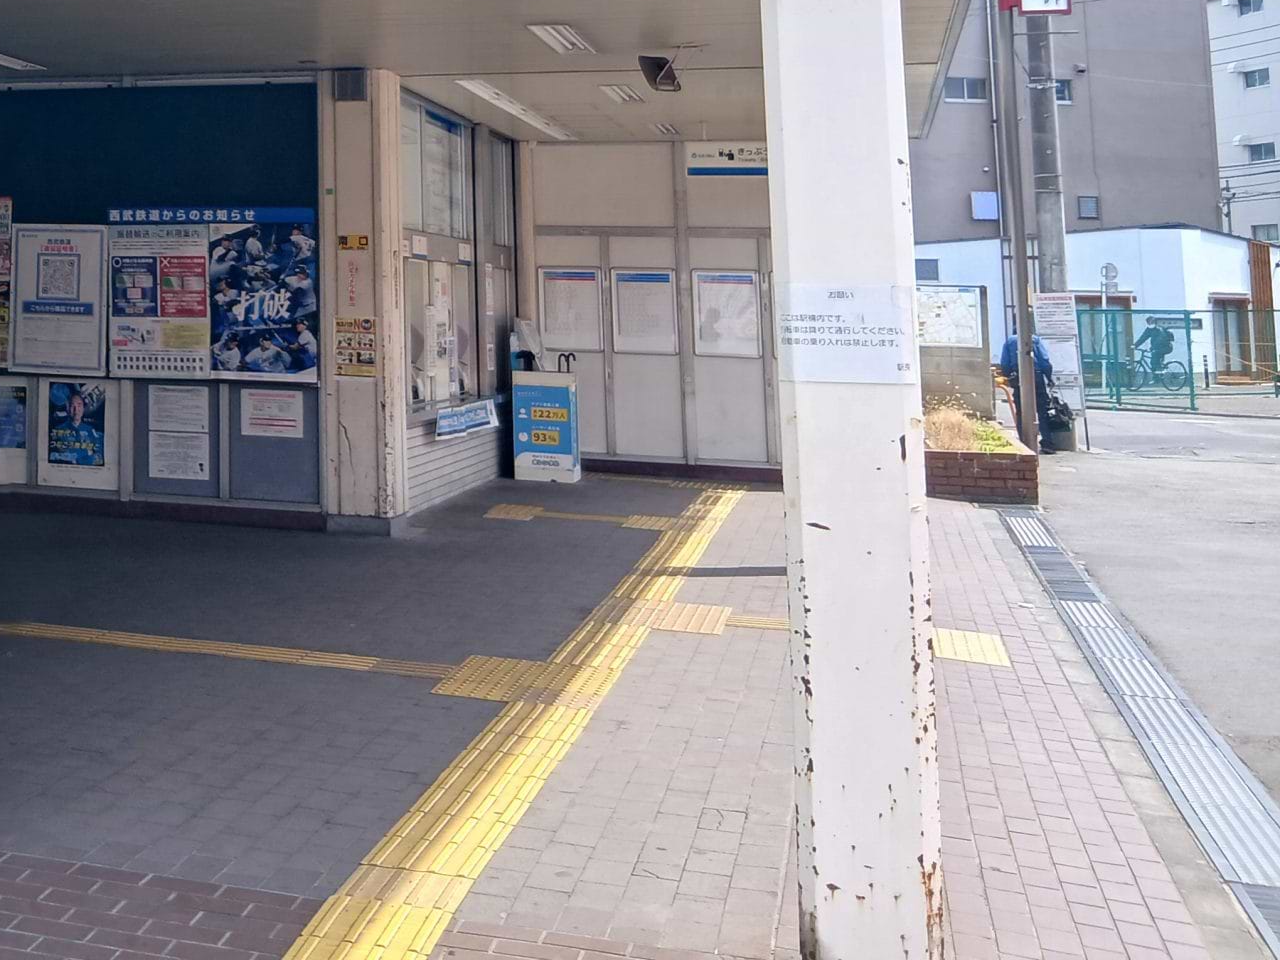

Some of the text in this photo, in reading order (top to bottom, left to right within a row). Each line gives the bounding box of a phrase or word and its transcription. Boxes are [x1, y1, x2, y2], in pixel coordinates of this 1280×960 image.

[109, 209, 256, 222] 西武鉄道からのお知らせ
[338, 236, 368, 246] 南口
[827, 290, 854, 299] お願い
[232, 288, 293, 321] 打破
